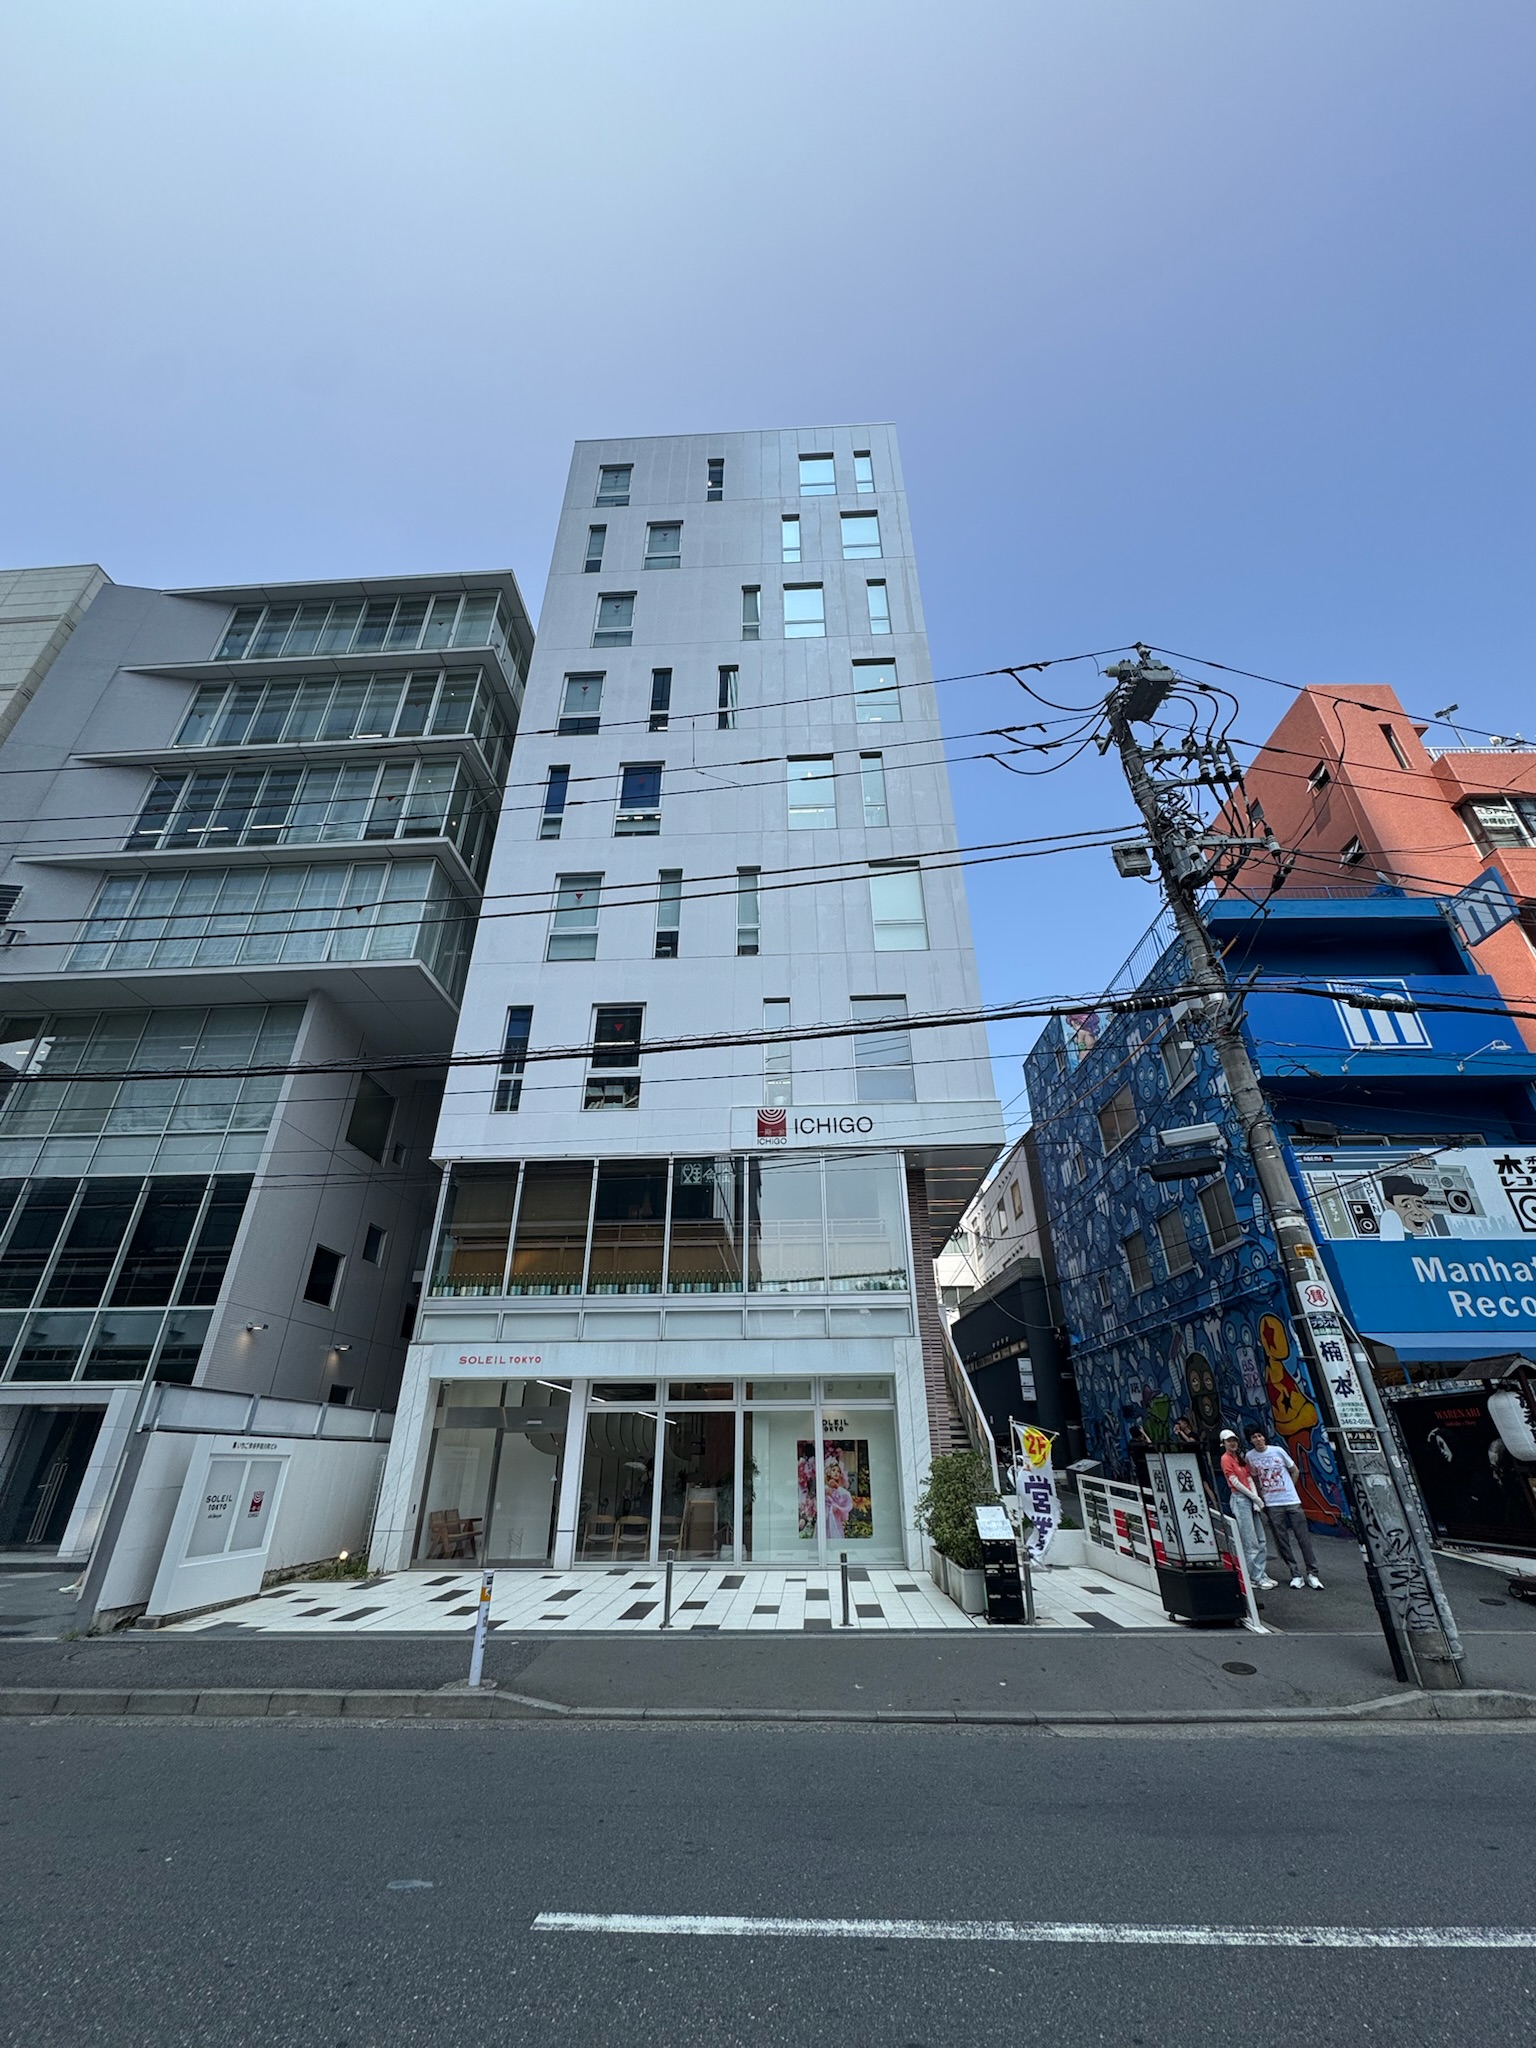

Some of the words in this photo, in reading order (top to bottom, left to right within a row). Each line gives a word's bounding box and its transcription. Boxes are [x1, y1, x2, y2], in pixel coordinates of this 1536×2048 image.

[795, 1117, 873, 1134] ICHIGO
[1501, 1176, 1536, 1187] レコ
[1363, 1181, 1381, 1214] OPEN
[1448, 1290, 1536, 1318] Reco
[459, 1356, 505, 1364] SOLEIL
[1241, 1359, 1255, 1372] BUS
[1320, 1340, 1354, 1398] 楠本
[1025, 1433, 1046, 1455] 2F
[206, 1495, 232, 1503] SOLEIL
[1182, 1498, 1209, 1544] 魚金
